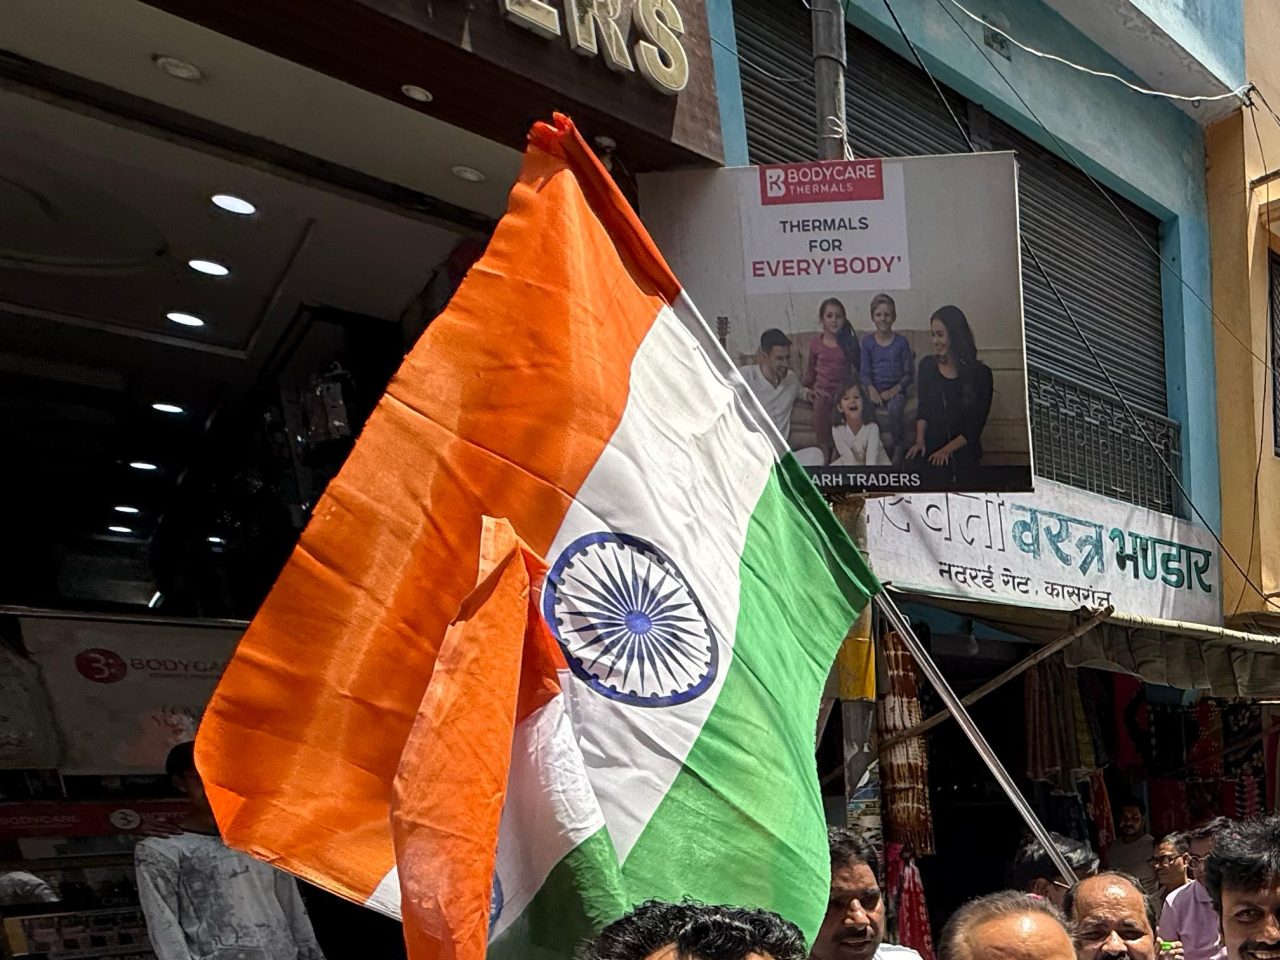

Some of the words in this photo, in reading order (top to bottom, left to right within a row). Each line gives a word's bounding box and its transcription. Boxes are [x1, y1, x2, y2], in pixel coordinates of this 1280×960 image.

[787, 164, 876, 183] BODYCARE
[789, 183, 854, 195] THERMALS
[780, 216, 869, 233] THERMALS
[809, 239, 842, 252] FOR
[811, 474, 842, 486] ARH
[847, 474, 920, 486] TRADERS
[1010, 503, 1106, 577] वस्त्र
[1108, 527, 1212, 593] भण्डार
